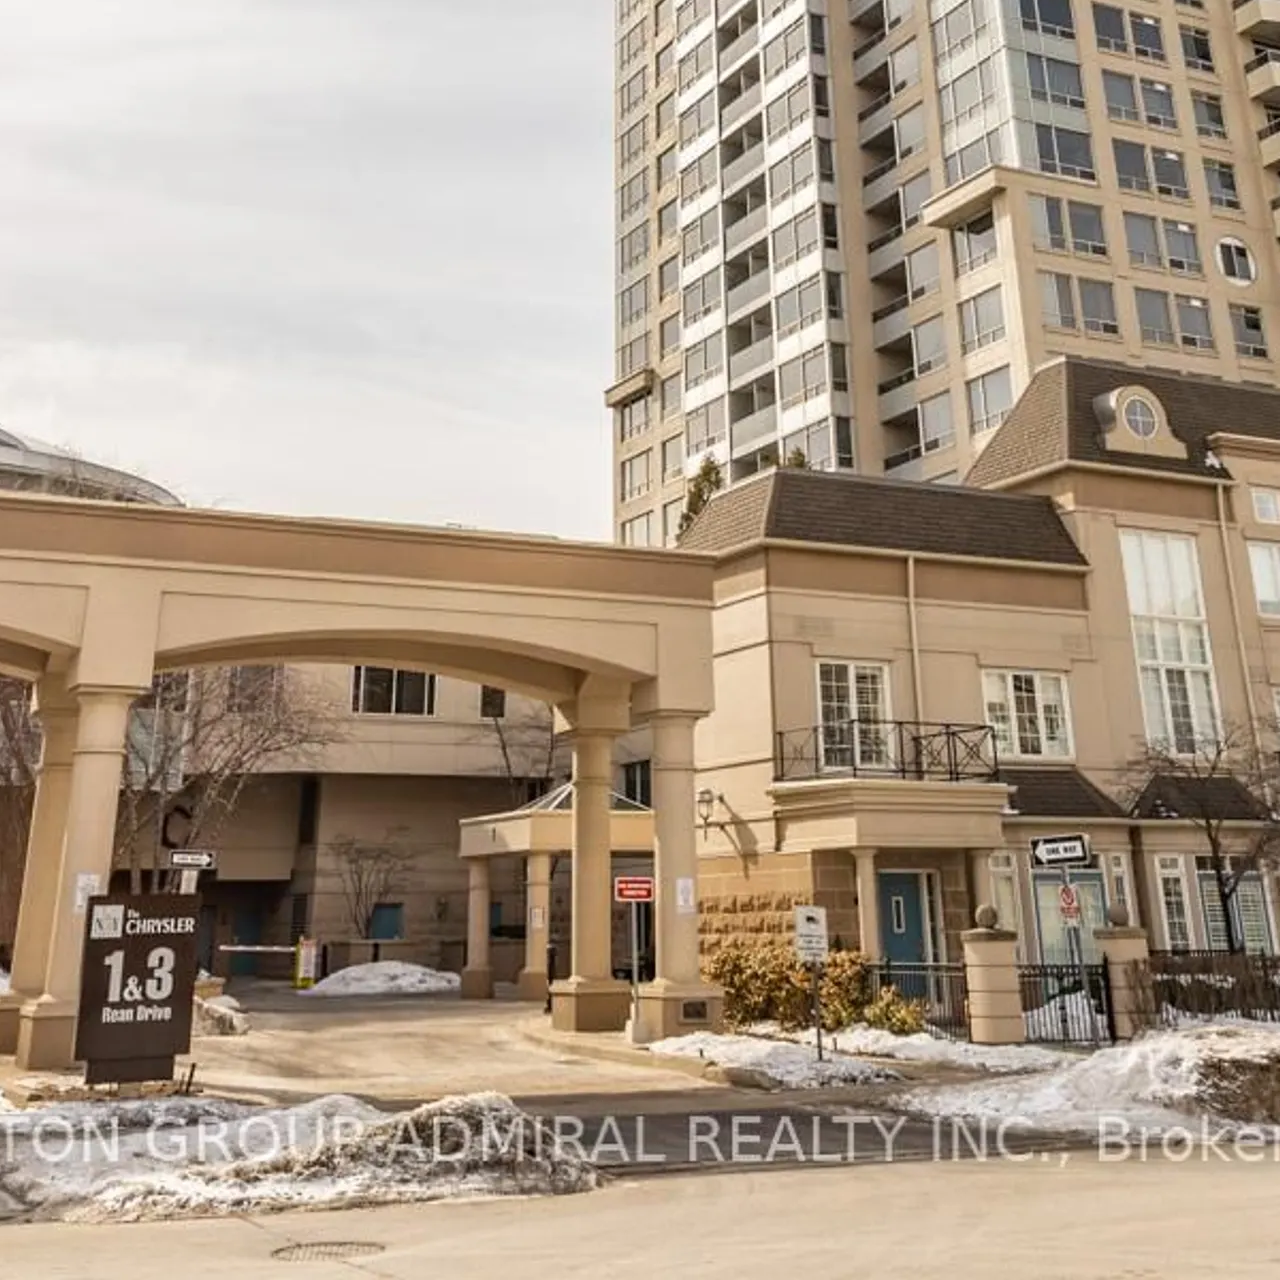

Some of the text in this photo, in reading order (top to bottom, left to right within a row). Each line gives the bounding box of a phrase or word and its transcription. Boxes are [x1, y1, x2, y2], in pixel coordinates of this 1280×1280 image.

[127, 909, 140, 919] The
[126, 917, 195, 935] CHRYSLER
[102, 1005, 172, 1024] Rean Drive
